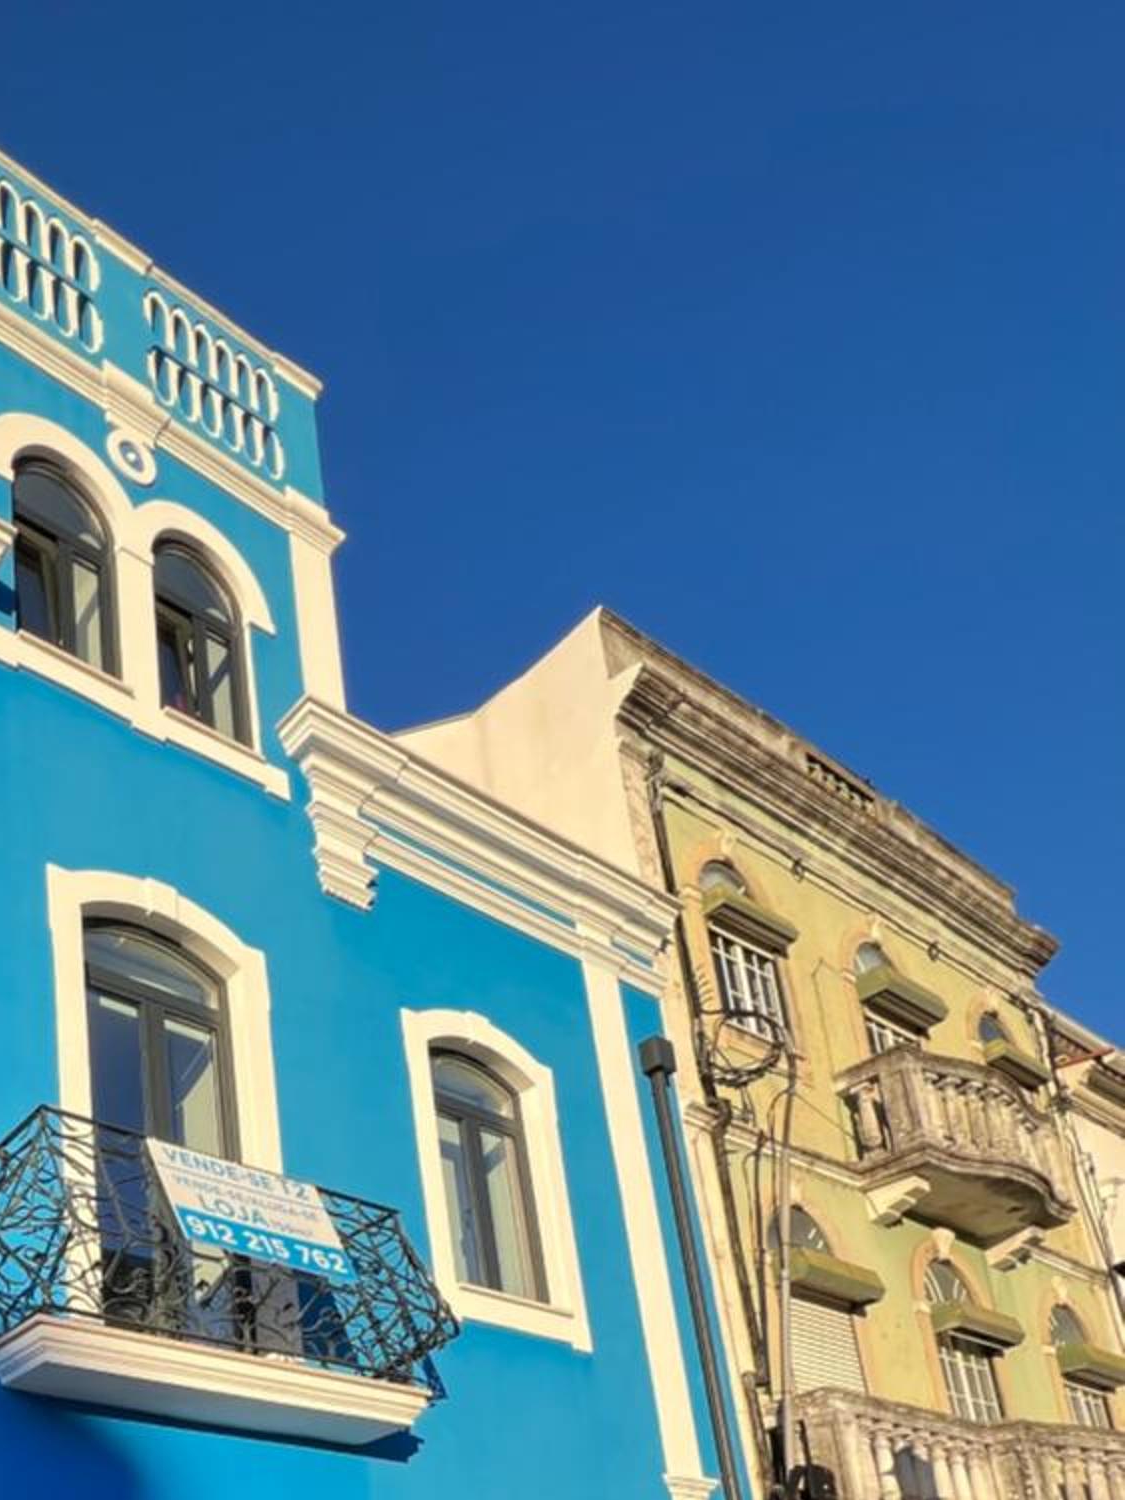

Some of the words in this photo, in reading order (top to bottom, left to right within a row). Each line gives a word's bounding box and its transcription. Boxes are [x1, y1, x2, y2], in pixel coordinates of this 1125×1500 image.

[163, 1146, 270, 1189] VENDE-SE
[197, 1194, 267, 1226] LOJA
[186, 1214, 238, 1246] 912
[242, 1231, 290, 1260] 215
[294, 1244, 348, 1274] 762
